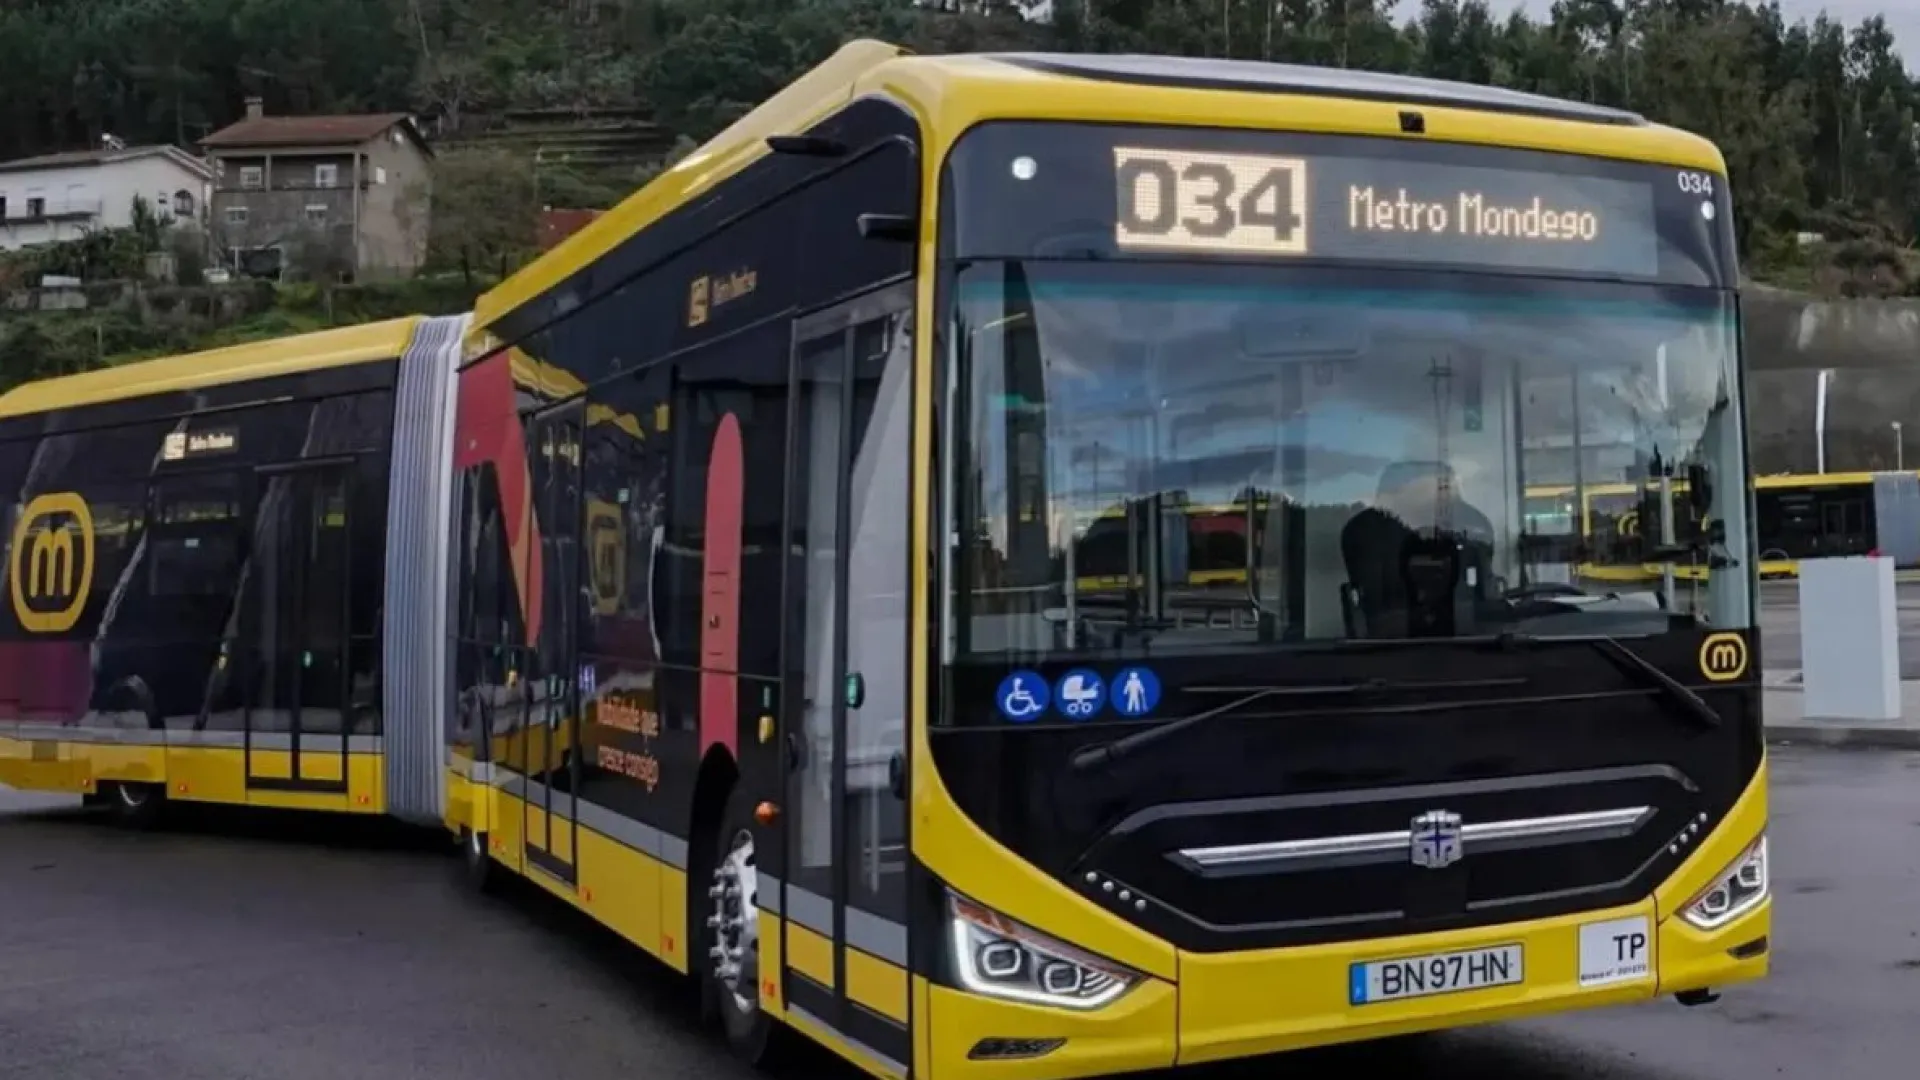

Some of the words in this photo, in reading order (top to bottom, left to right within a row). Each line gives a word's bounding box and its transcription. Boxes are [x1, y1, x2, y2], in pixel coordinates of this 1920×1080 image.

[1116, 158, 1302, 242] 034
[1677, 171, 1713, 197] 034
[1349, 184, 1448, 233] Metro
[1459, 191, 1598, 241] Mondego
[1612, 931, 1646, 961] TP
